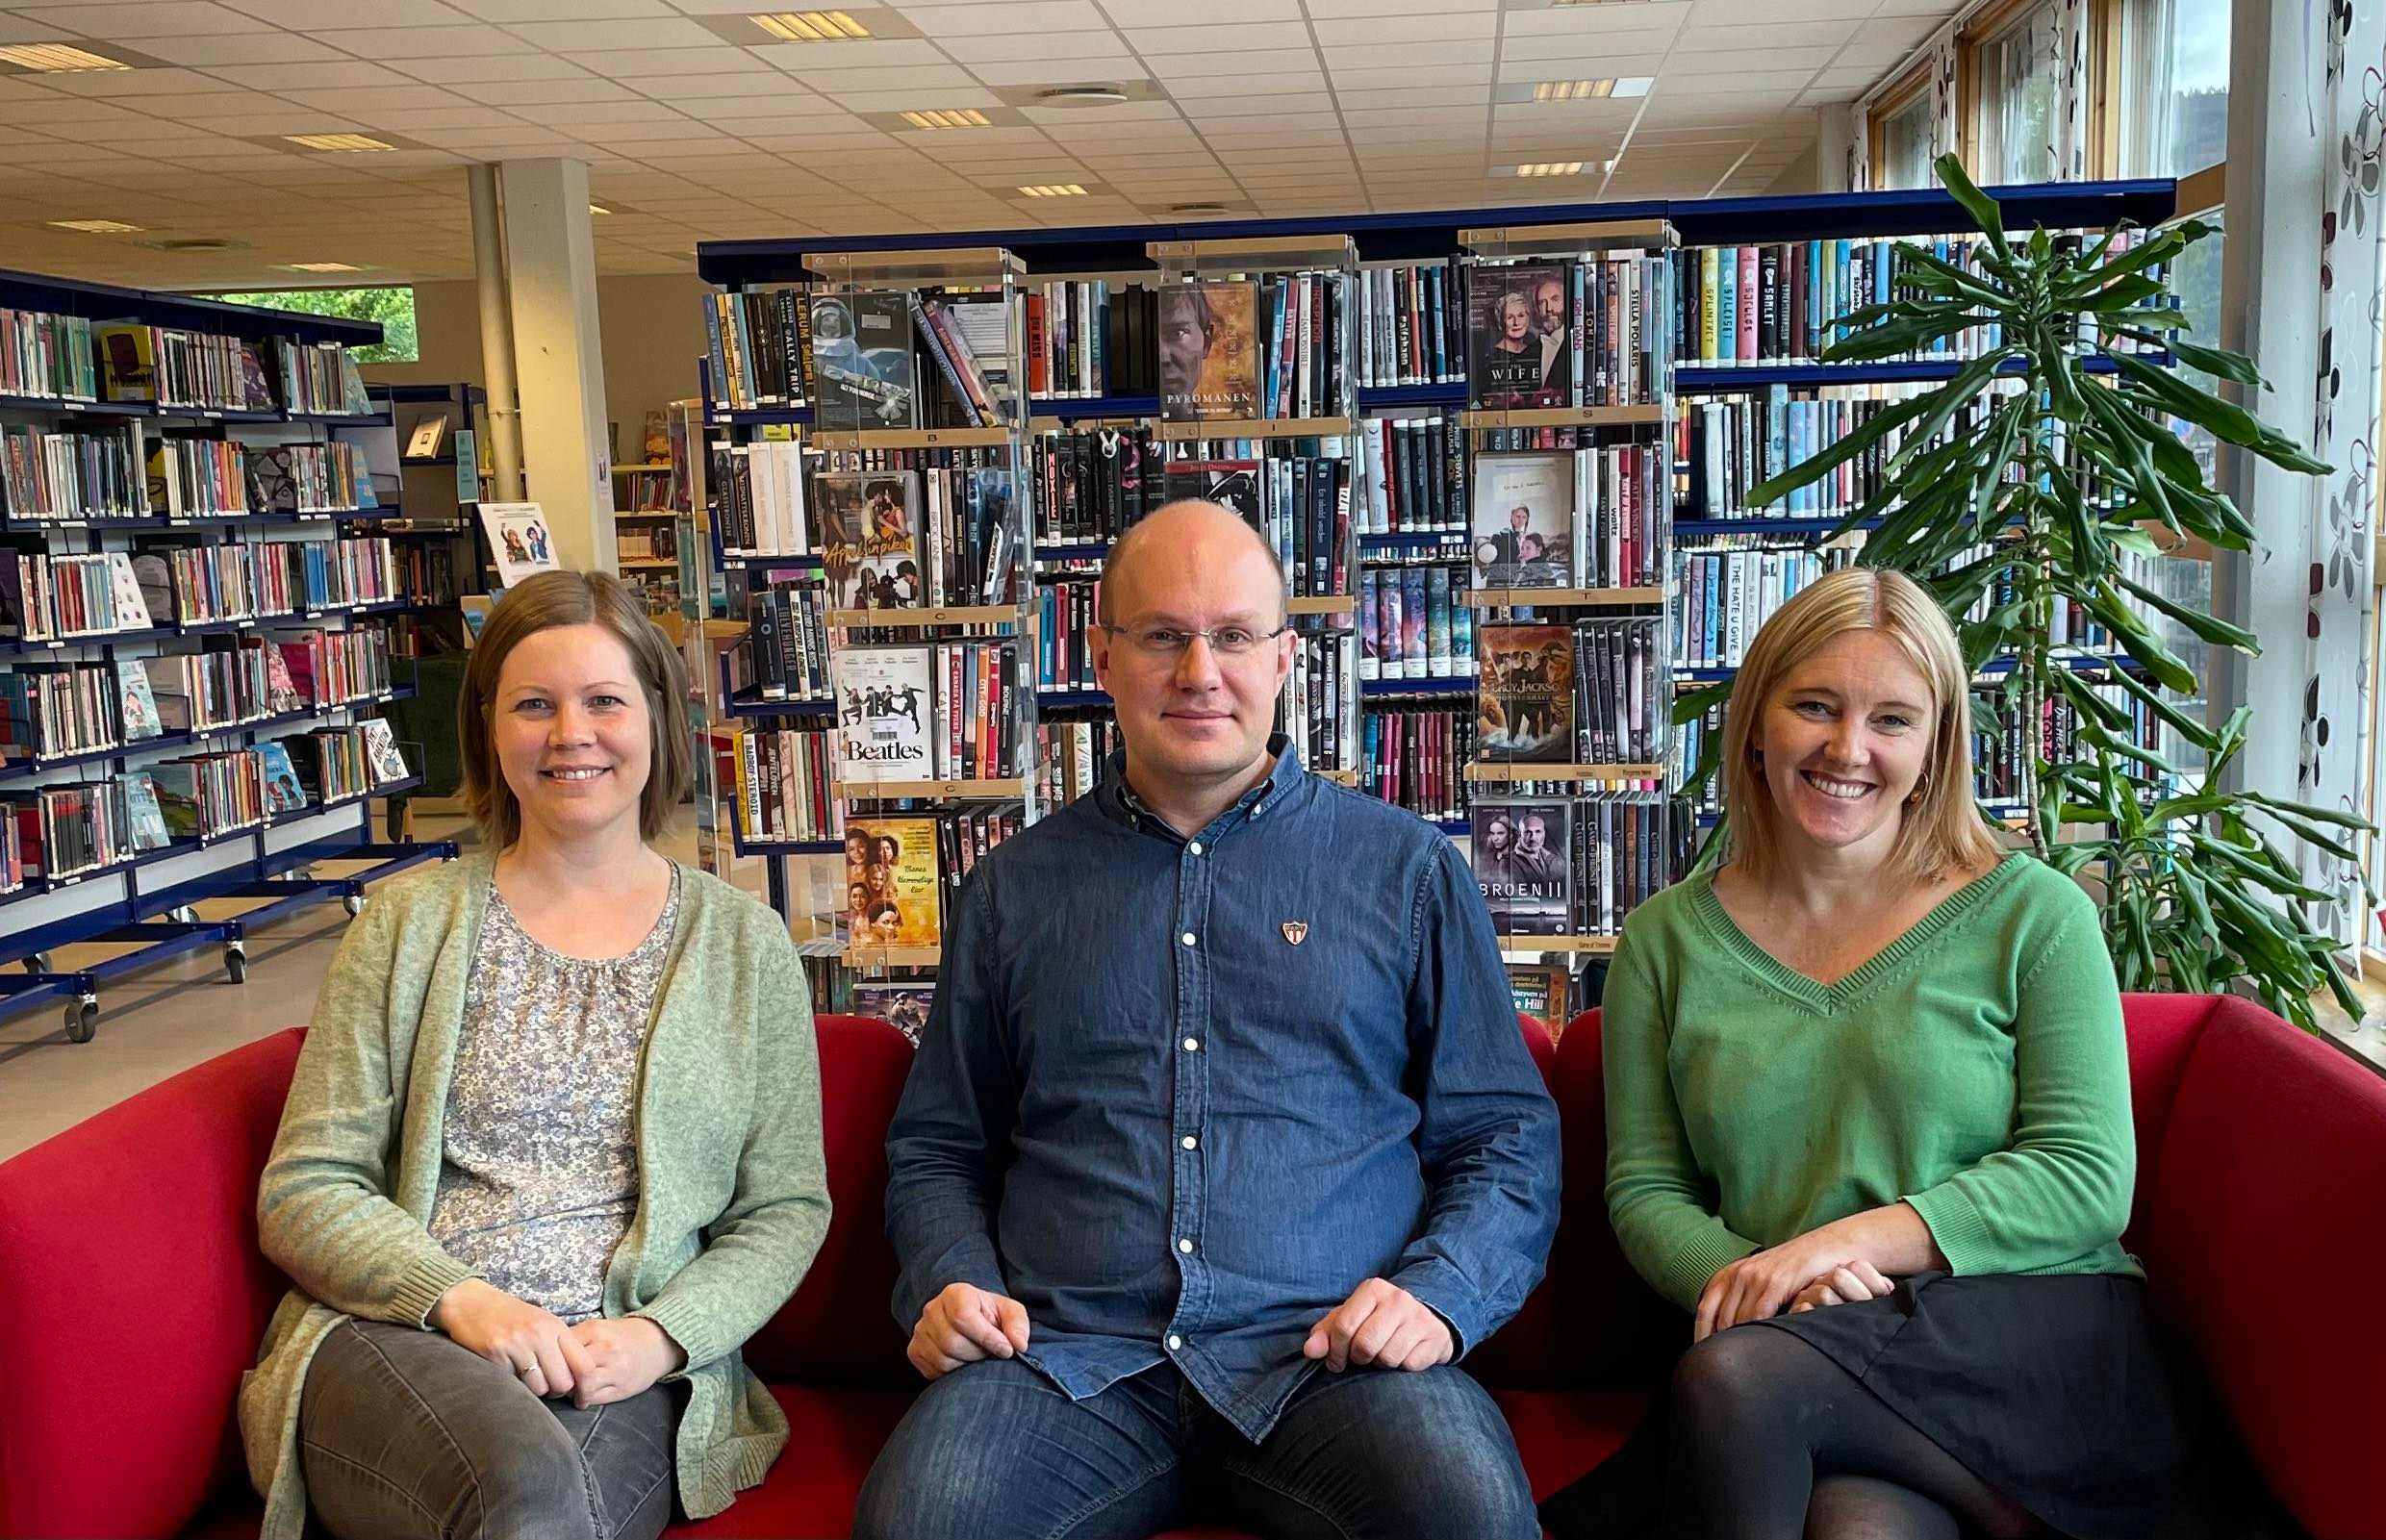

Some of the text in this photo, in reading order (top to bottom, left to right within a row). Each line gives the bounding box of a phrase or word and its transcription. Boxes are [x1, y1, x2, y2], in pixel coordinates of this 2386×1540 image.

[797, 297, 809, 339] LERUM
[1312, 286, 1321, 343] INCEPTION
[1705, 289, 1714, 344] SPLINTRET
[1723, 289, 1733, 340] SPLEISET
[1764, 288, 1774, 327] SAMLET
[1300, 318, 1309, 369] IMPOSSIBLE
[1586, 310, 1594, 352] SONJA
[1631, 290, 1639, 367] STELLA POLARIS
[1491, 367, 1539, 380] WIFE
[1167, 392, 1250, 404] PYROMANEN
[927, 434, 937, 442] B
[1048, 452, 1057, 518] MOXIE
[1317, 499, 1327, 518] iskald
[930, 511, 940, 563] BRICK LANE
[1317, 520, 1326, 543] verden
[1582, 592, 1592, 600] T
[1731, 565, 1741, 650] THE HATE U GIVE
[938, 691, 948, 724] CAKE
[848, 741, 924, 761] Beatles
[745, 745, 758, 816] BADBOY STEROID
[944, 784, 955, 793] C
[1334, 774, 1345, 783] K
[1588, 821, 1597, 846] GAME
[1588, 853, 1597, 887] THRONES
[1480, 881, 1561, 897] BROEN II
[1524, 997, 1544, 1010] Hill
